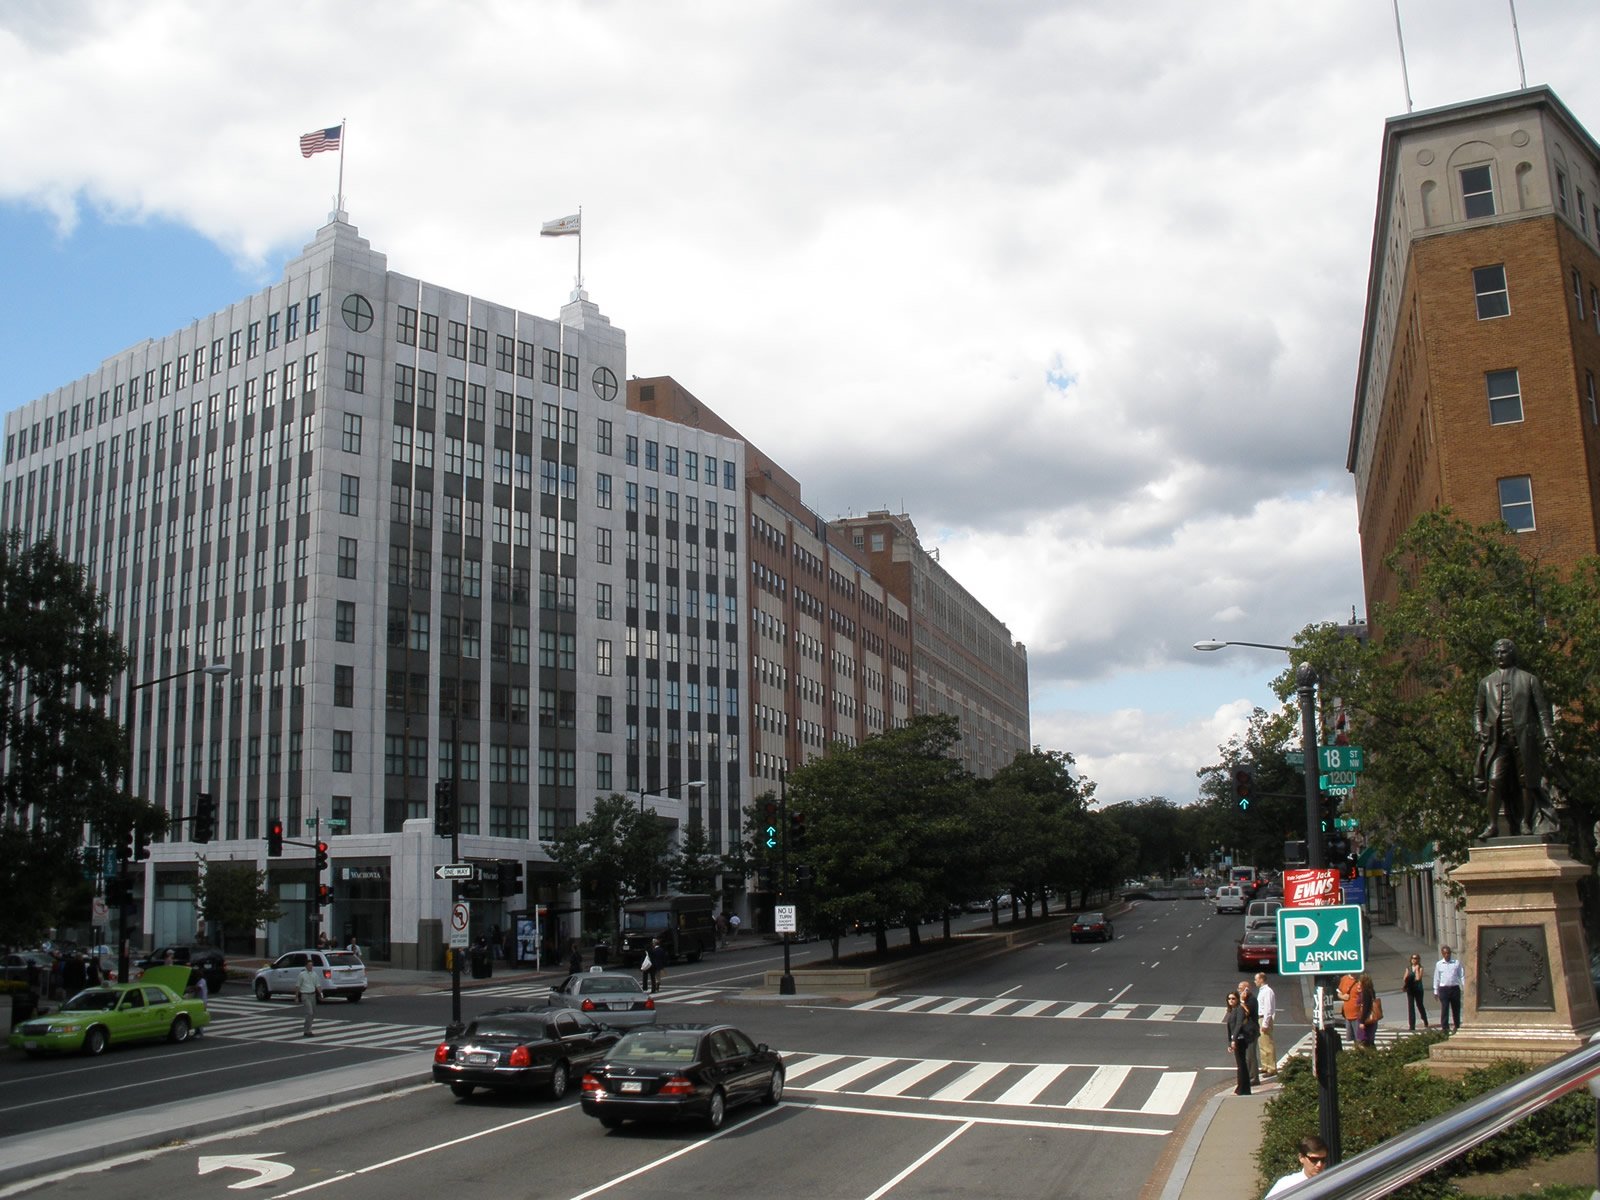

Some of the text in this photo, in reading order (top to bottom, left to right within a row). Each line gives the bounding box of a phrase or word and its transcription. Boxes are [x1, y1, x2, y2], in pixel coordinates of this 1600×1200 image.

[1349, 750, 1358, 758] ST
[1324, 749, 1340, 768] 18
[1349, 759, 1360, 767] NW
[1329, 772, 1352, 783] 1200
[1328, 788, 1347, 796] 1700
[1316, 871, 1332, 880] Jack
[1293, 877, 1335, 900] EVANS
[1330, 898, 1336, 906] 2
